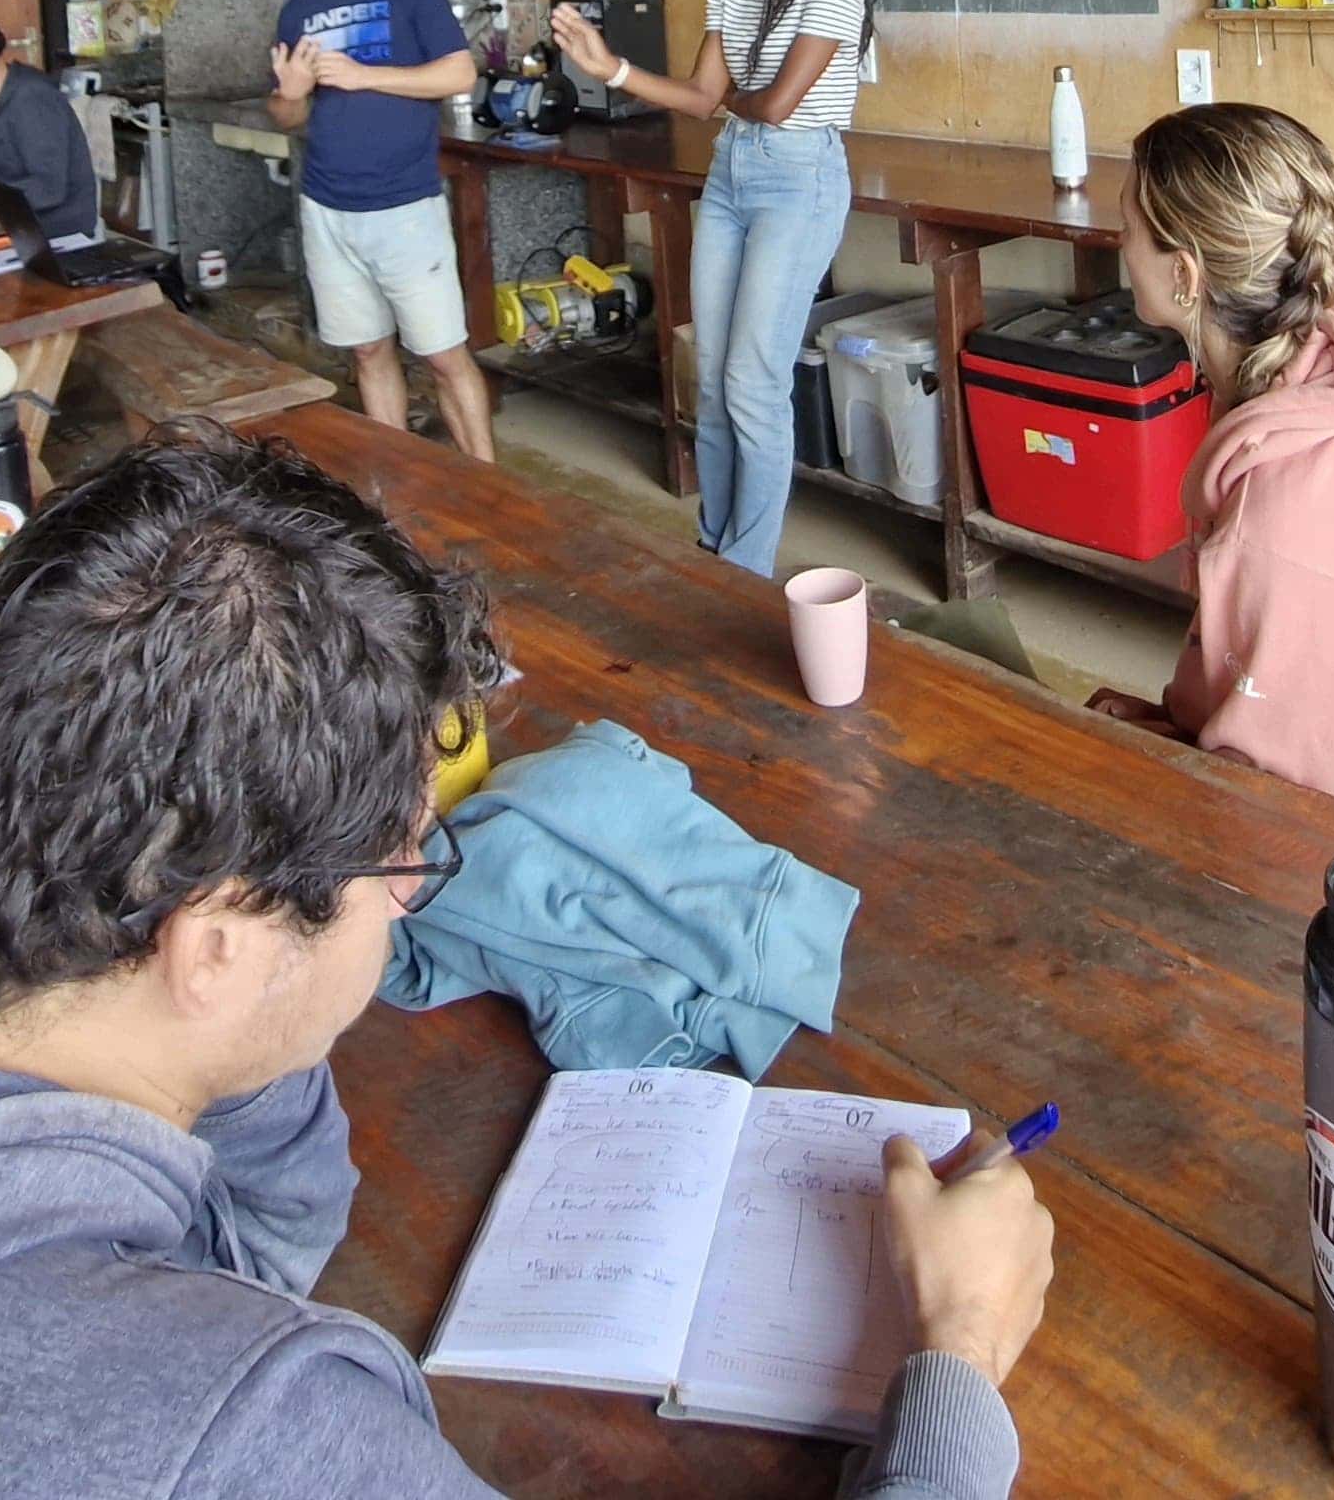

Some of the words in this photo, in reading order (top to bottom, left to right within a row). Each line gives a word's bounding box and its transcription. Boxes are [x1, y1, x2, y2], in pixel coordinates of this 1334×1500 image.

[303, 0, 390, 34] UNDER
[628, 1077, 654, 1094] 06
[845, 1109, 875, 1128] 07
